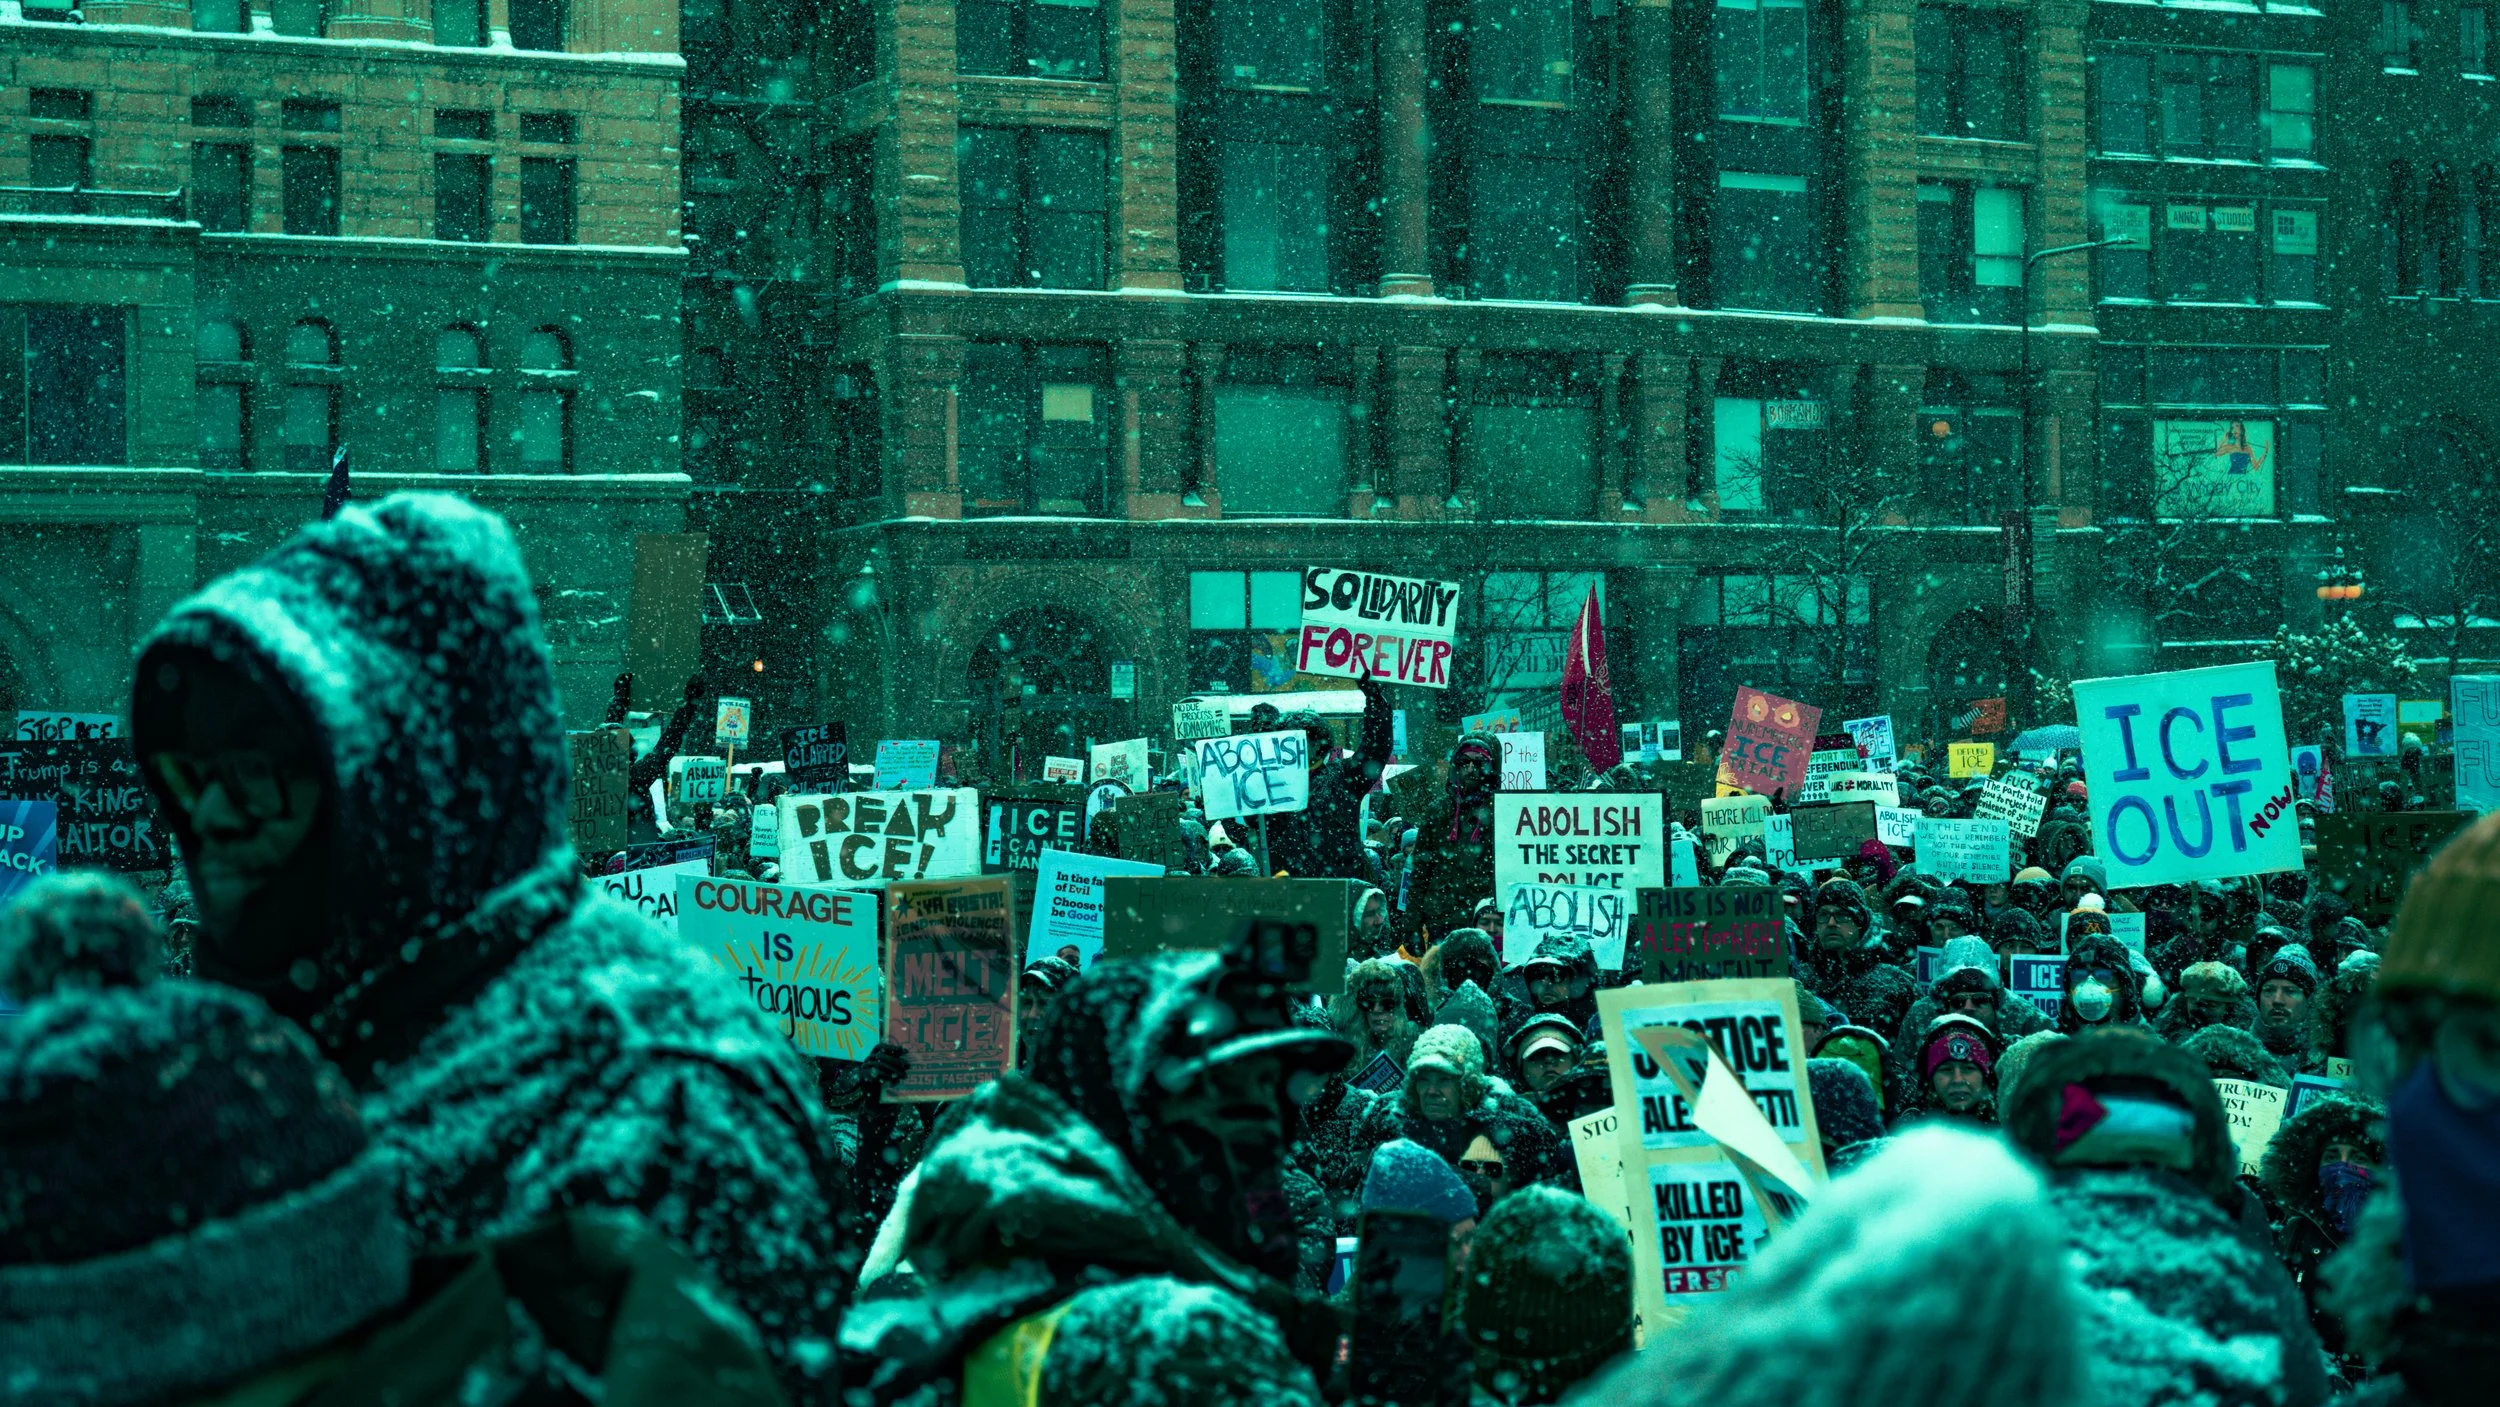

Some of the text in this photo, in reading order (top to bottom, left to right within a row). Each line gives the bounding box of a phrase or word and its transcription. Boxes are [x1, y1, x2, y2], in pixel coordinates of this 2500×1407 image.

[2173, 211, 2200, 225] ANNEX
[2217, 212, 2253, 226] STUDIOS
[1304, 567, 1457, 627] SOLIDARITY
[1299, 625, 1452, 685] FOREVER
[1174, 702, 1200, 713] NO DUE
[1181, 710, 1213, 721] PROCESS
[2454, 681, 2500, 727] FU
[18, 717, 72, 741] STOP
[795, 724, 829, 747] ICE
[1176, 719, 1228, 738] KIDNAPPING
[2104, 692, 2262, 783] ICE
[787, 743, 847, 769] CLAPPED
[1111, 754, 1127, 767] ICE
[1200, 736, 1307, 778] ABOLISH
[1518, 745, 1538, 763] the
[1734, 735, 1790, 768] ICE
[1811, 752, 1838, 763] PPORT
[1871, 757, 1892, 769] THE
[1962, 755, 1986, 768] ICE
[2456, 740, 2500, 788] FU
[0, 752, 127, 787] Trump is a
[685, 765, 725, 781] ABOLISH
[1501, 770, 1533, 789] RROR
[1729, 756, 1789, 782] TRIALS
[1806, 760, 1859, 774] EFERENDUM
[689, 781, 718, 799] ICE
[1232, 766, 1297, 814] ICE
[1857, 780, 1894, 791] MORALITY
[1986, 778, 2044, 806] The party told
[2006, 774, 2034, 791] FUCK
[1975, 809, 1991, 819] eyes
[1980, 790, 1996, 799] you
[2005, 797, 2027, 811] reject
[2028, 804, 2042, 816] the
[2249, 785, 2294, 839] NOW
[796, 793, 957, 843] BREAK
[1010, 808, 1076, 837] ICE
[1515, 806, 1641, 837] ABOLISH
[1795, 808, 1842, 832] MELT
[1879, 810, 1917, 824] ABOLISH
[1917, 821, 1999, 833] IN THE END
[2007, 807, 2017, 817] of
[2017, 813, 2038, 825] your
[2107, 779, 2252, 866] OUT
[57, 820, 155, 854] AITOR
[1887, 823, 1911, 839] ICE
[1965, 834, 2008, 842] REMEMBER
[2363, 823, 2430, 854] ICE
[809, 834, 936, 882] ICE!
[1008, 838, 1074, 853] CAN'T
[1518, 843, 1641, 865] THE SECRET
[0, 850, 46, 876] ACK
[1008, 855, 1040, 870] HAN
[1971, 861, 2000, 871] SILENCE
[1055, 883, 1091, 896] of Evil
[1056, 871, 1104, 886] In the fa
[638, 890, 678, 919] CA
[694, 880, 854, 927] COURAGE
[1051, 906, 1099, 922] be Good
[1053, 896, 1104, 912] Choose t
[1509, 887, 1624, 940] ABOLISH
[1641, 891, 1778, 918] THIS IS NOT
[762, 930, 794, 963] IS
[1642, 923, 1658, 951] A
[1664, 920, 1710, 953] LEFT
[1731, 919, 1783, 956] RIGHT
[903, 950, 991, 998] MELT
[2030, 964, 2061, 989] ICE
[738, 966, 852, 1039] tagious
[1632, 1015, 1790, 1080] JTICE
[2335, 1062, 2355, 1077] ST
[2216, 1082, 2278, 1103] TRUMP'S
[1643, 1094, 1700, 1134] ALE
[1582, 1115, 1618, 1140] STO
[1655, 1180, 1744, 1222] KILLED
[1661, 1223, 1748, 1265] BY ICE
